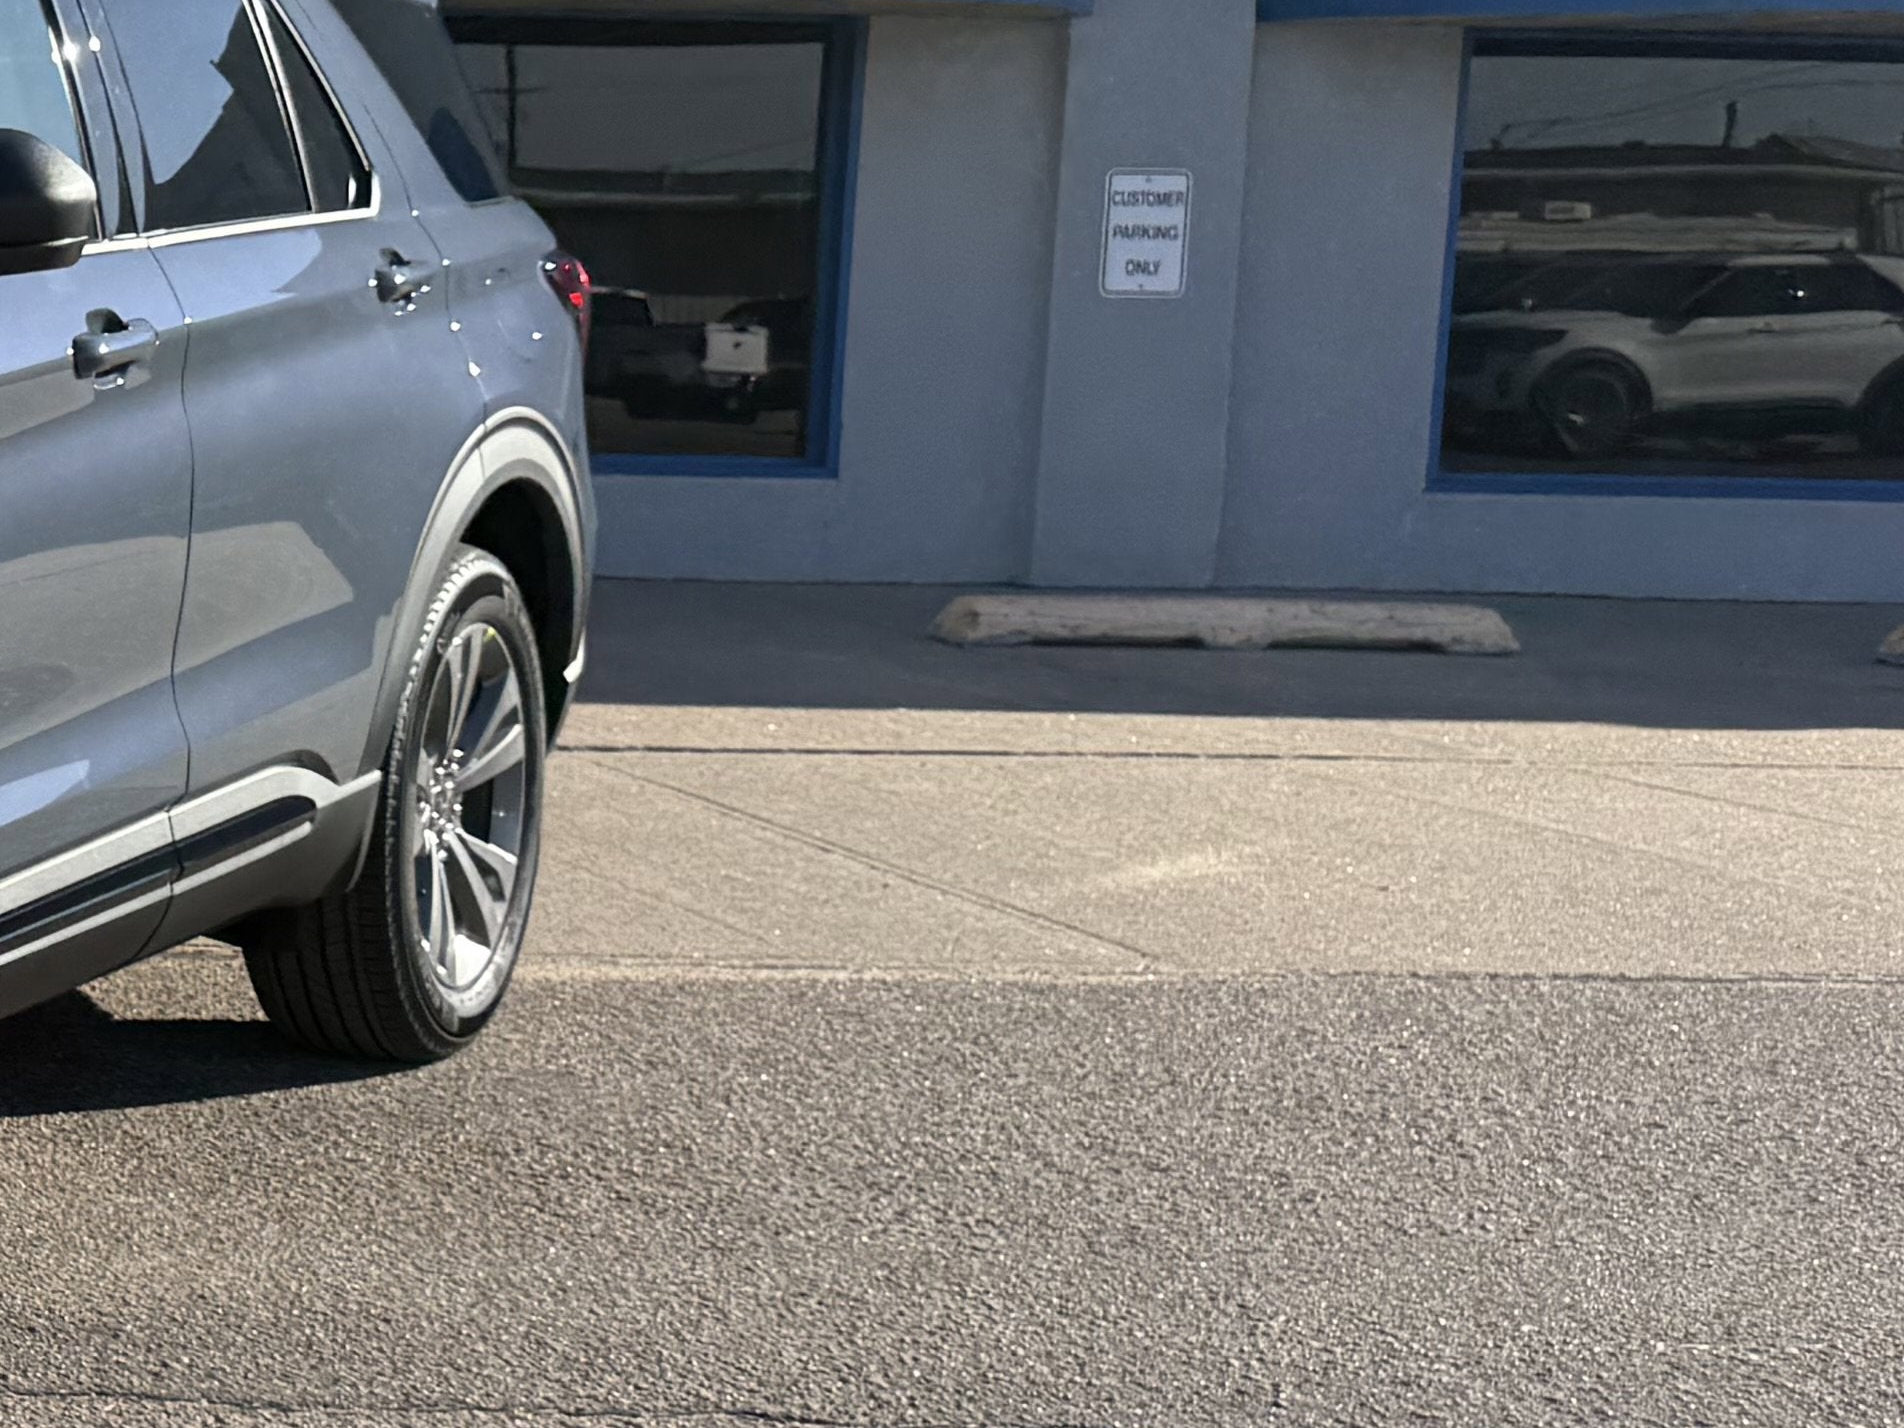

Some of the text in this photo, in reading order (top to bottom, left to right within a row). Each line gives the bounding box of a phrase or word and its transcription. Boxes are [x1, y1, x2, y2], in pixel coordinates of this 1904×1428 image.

[1112, 190, 1184, 207] CUSTOMER
[1112, 223, 1179, 241] PARKING
[1124, 258, 1161, 276] ONLY
